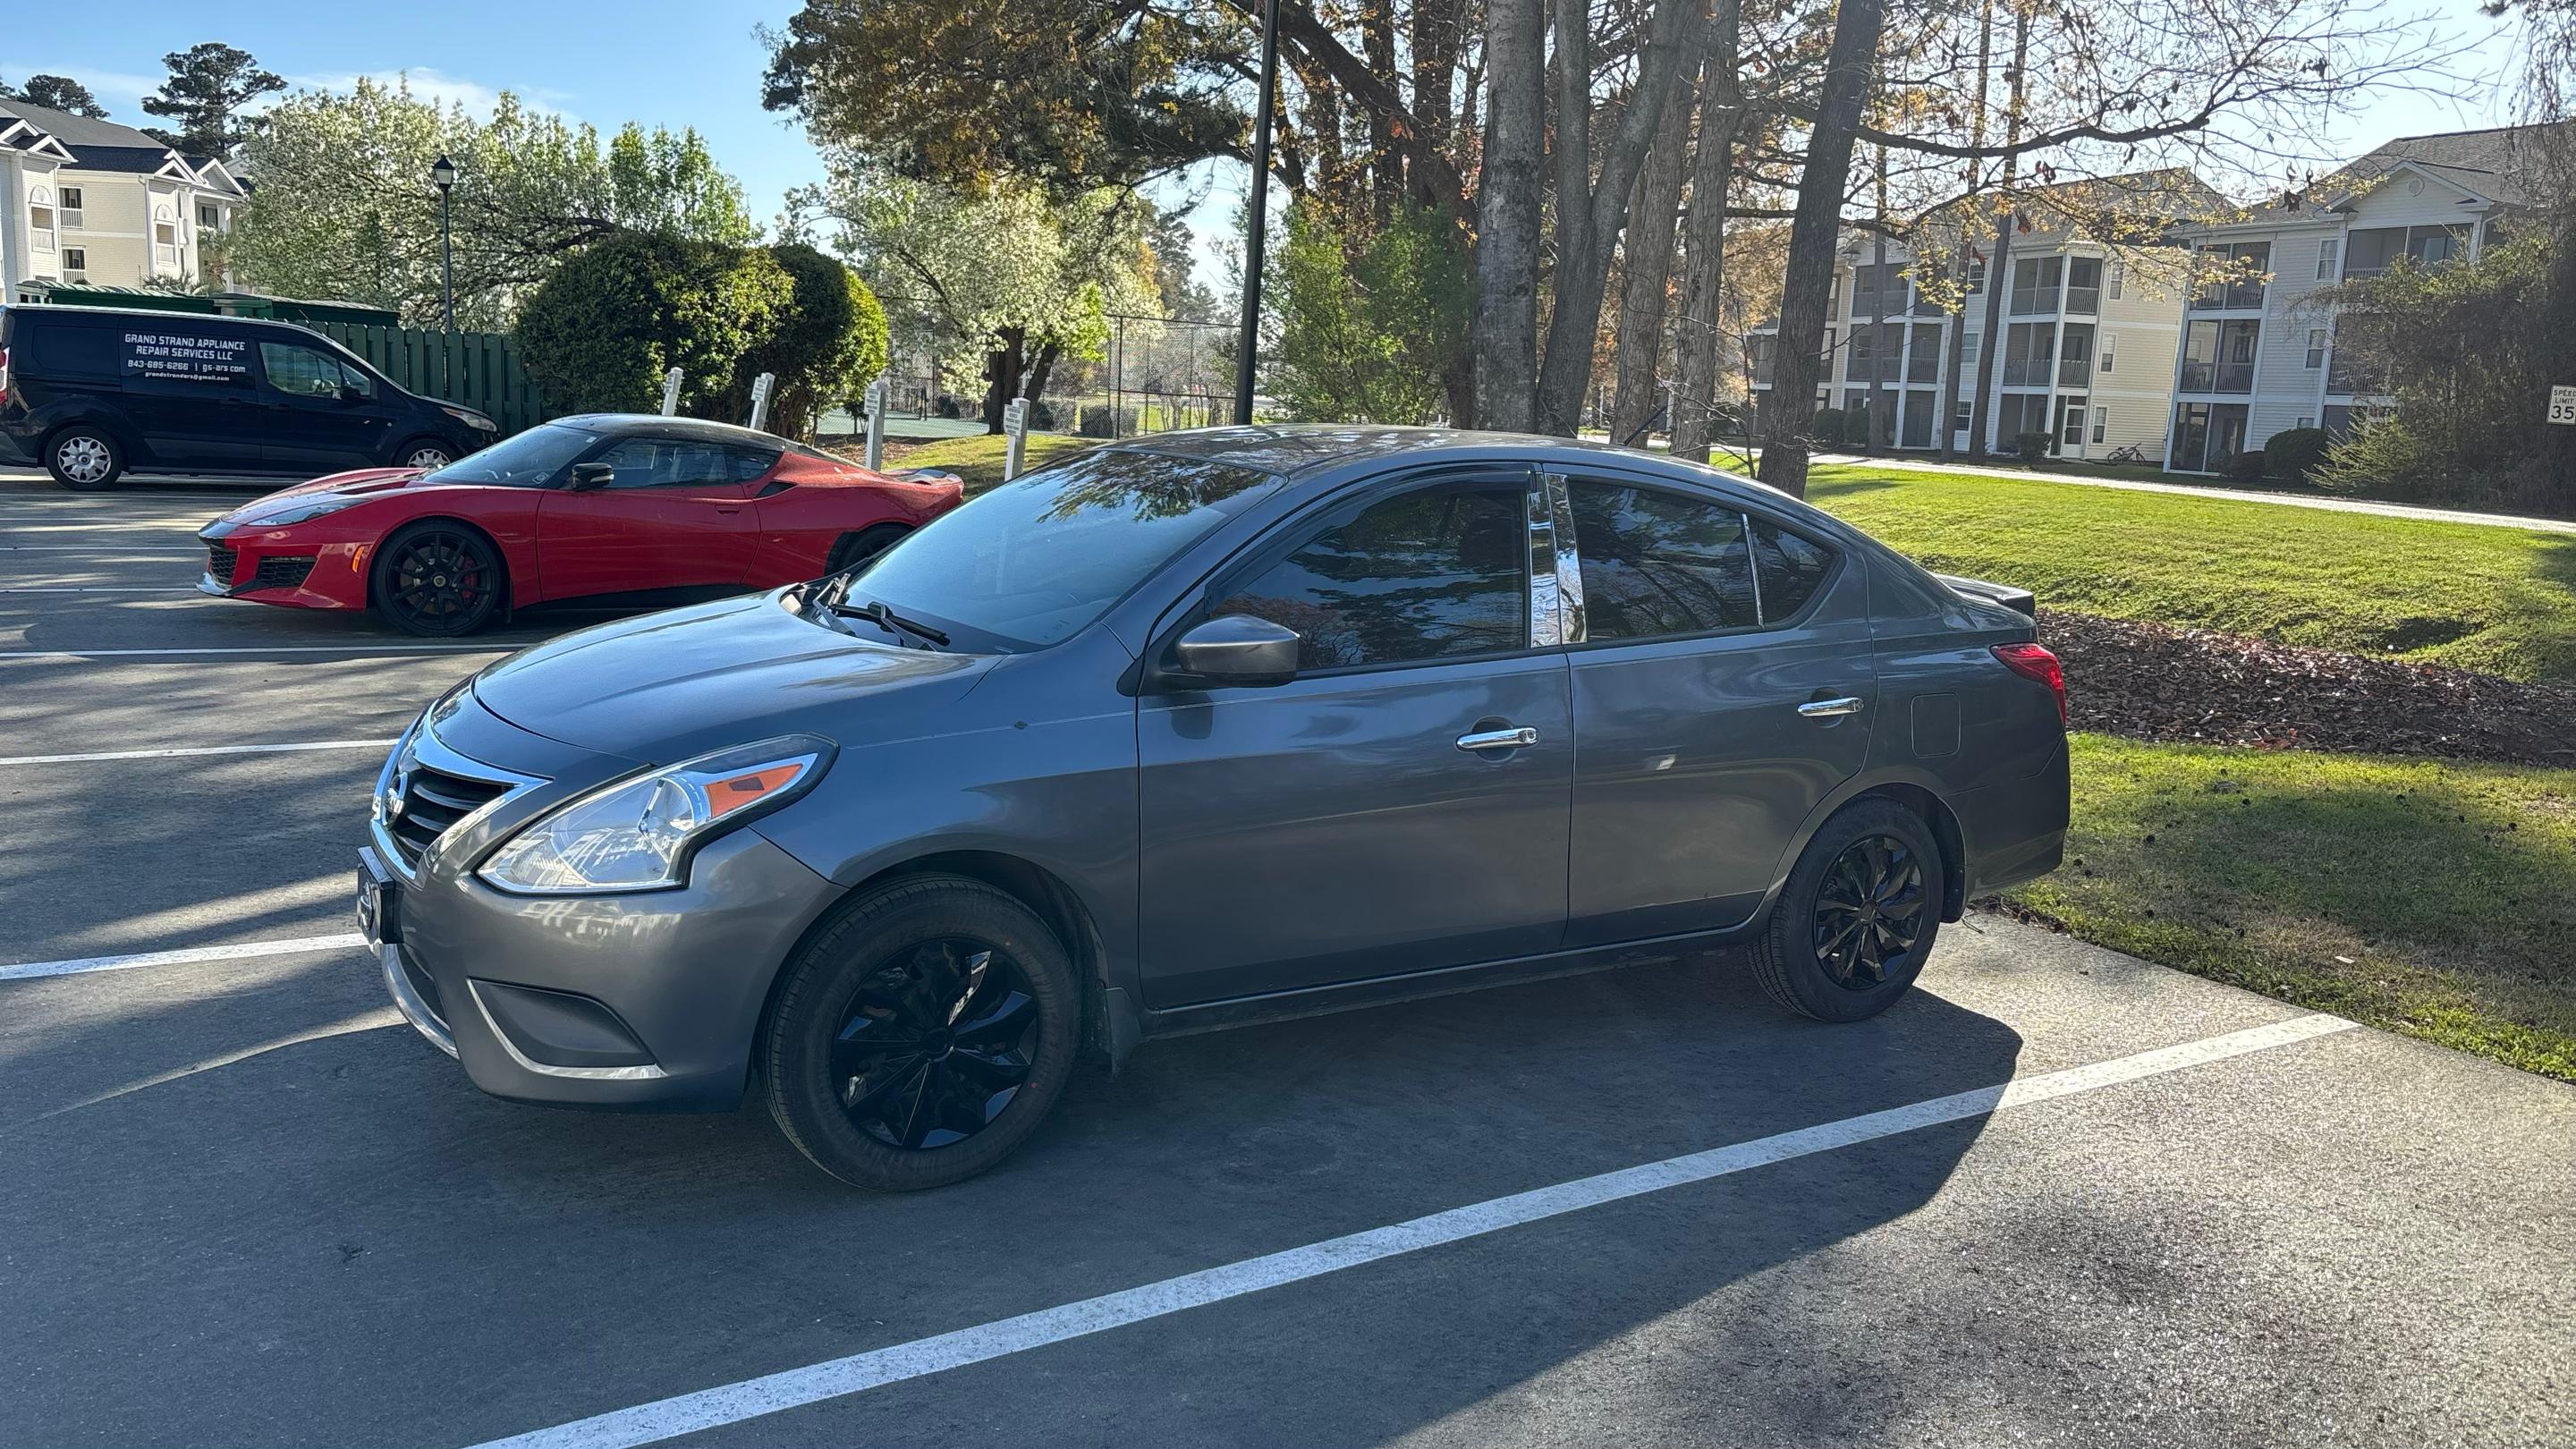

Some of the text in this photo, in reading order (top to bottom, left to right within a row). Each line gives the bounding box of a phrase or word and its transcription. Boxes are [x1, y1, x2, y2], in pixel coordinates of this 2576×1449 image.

[125, 334, 246, 351] GRAND STRAND APPLIANCE
[136, 345, 233, 360] REPAIR SERVICES LLC
[2551, 405, 2574, 419] 35
